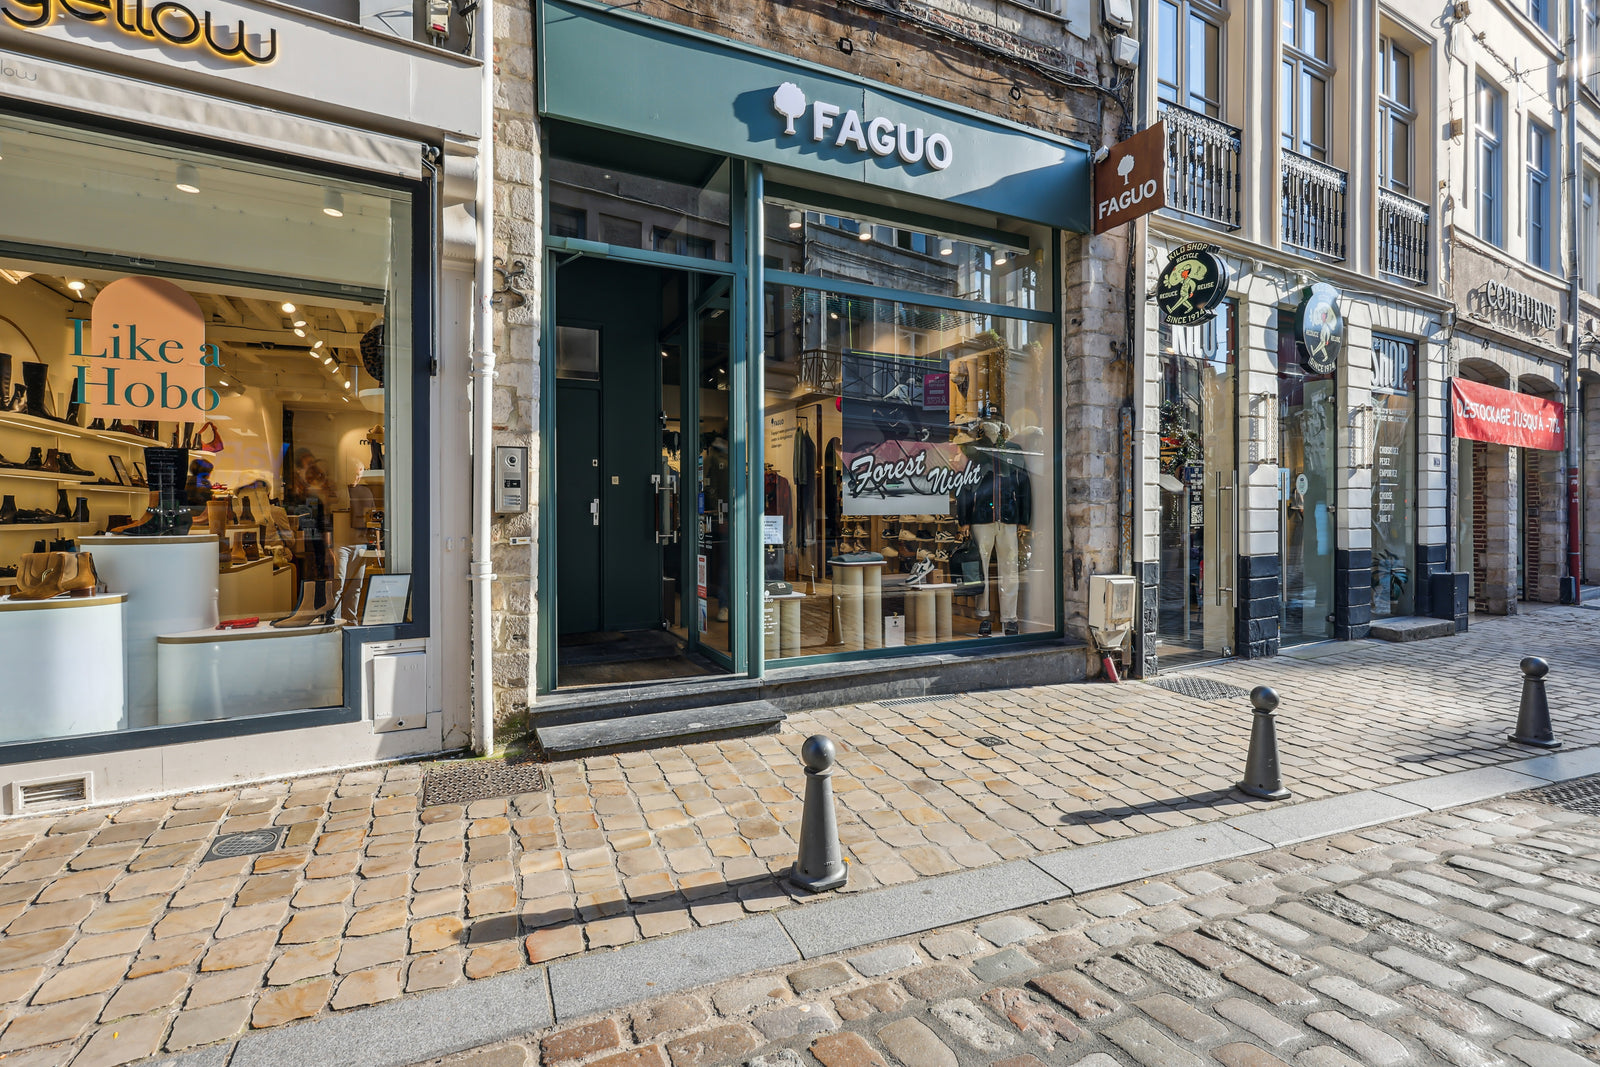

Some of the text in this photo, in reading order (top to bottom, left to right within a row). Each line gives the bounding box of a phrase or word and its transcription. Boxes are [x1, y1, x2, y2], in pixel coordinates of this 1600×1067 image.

[813, 100, 953, 170] FAGUO
[1098, 179, 1157, 220] FAGUO
[1168, 242, 1208, 261] KILO SHOP
[1176, 252, 1199, 263] RECYCLE
[1159, 290, 1178, 300] REDUCE
[1197, 281, 1215, 291] REUSE
[1165, 308, 1206, 324] SINCE 1974
[1486, 279, 1557, 331] COTHURNE
[68, 318, 225, 367] Like a
[1309, 357, 1324, 372] SINCE
[71, 365, 220, 411] Hobo
[1456, 398, 1511, 426] DESTOCKAGE
[851, 449, 982, 497] Forest Night
